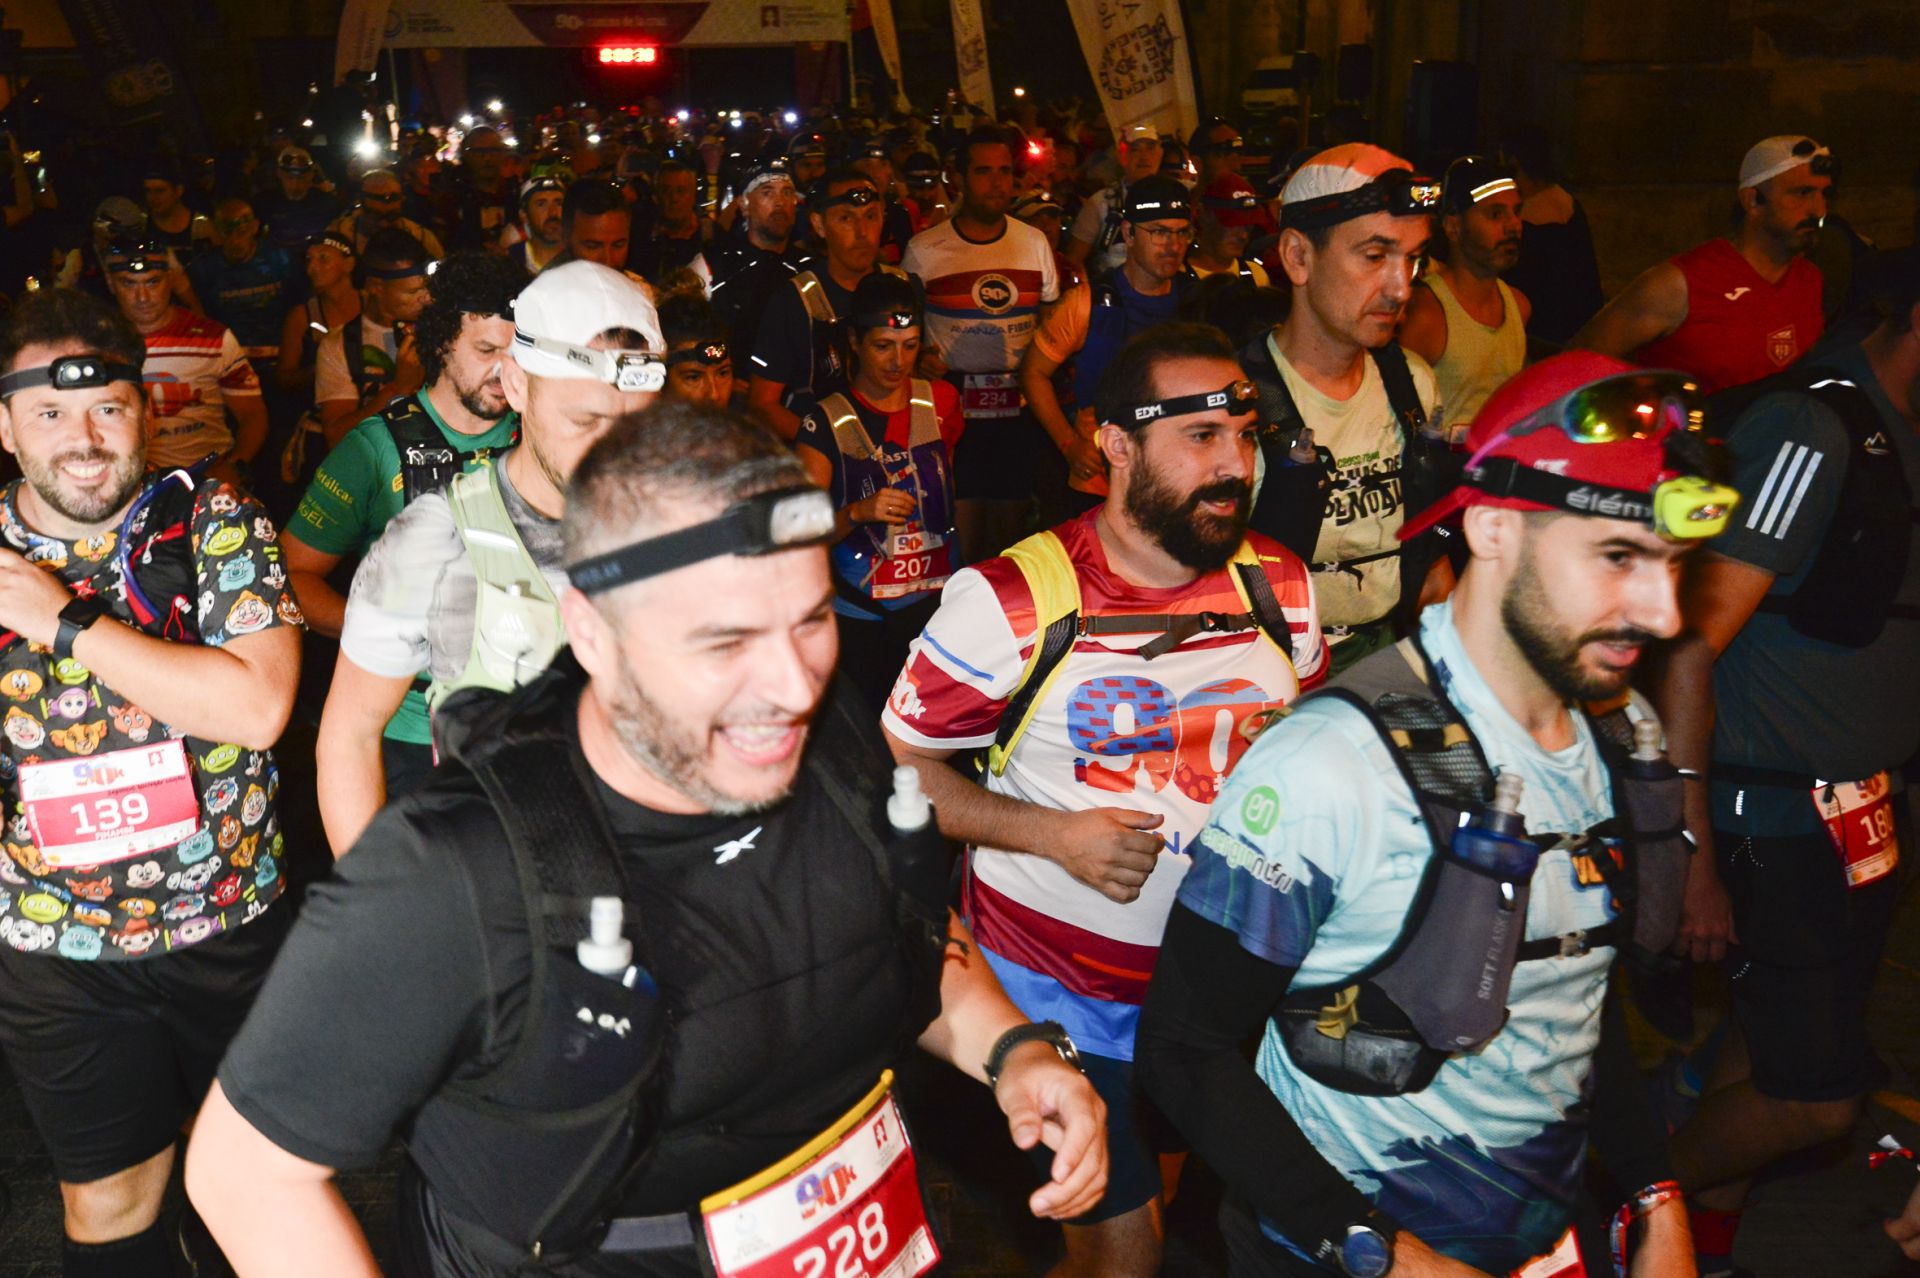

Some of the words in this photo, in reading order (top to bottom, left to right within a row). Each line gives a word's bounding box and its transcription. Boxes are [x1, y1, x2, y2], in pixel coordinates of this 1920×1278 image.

[978, 391, 1009, 407] 234
[1134, 404, 1163, 421] EDM
[893, 555, 932, 579] 207
[70, 792, 150, 836] 139
[1477, 961, 1498, 1001] SOFT
[792, 1201, 889, 1278] 228
